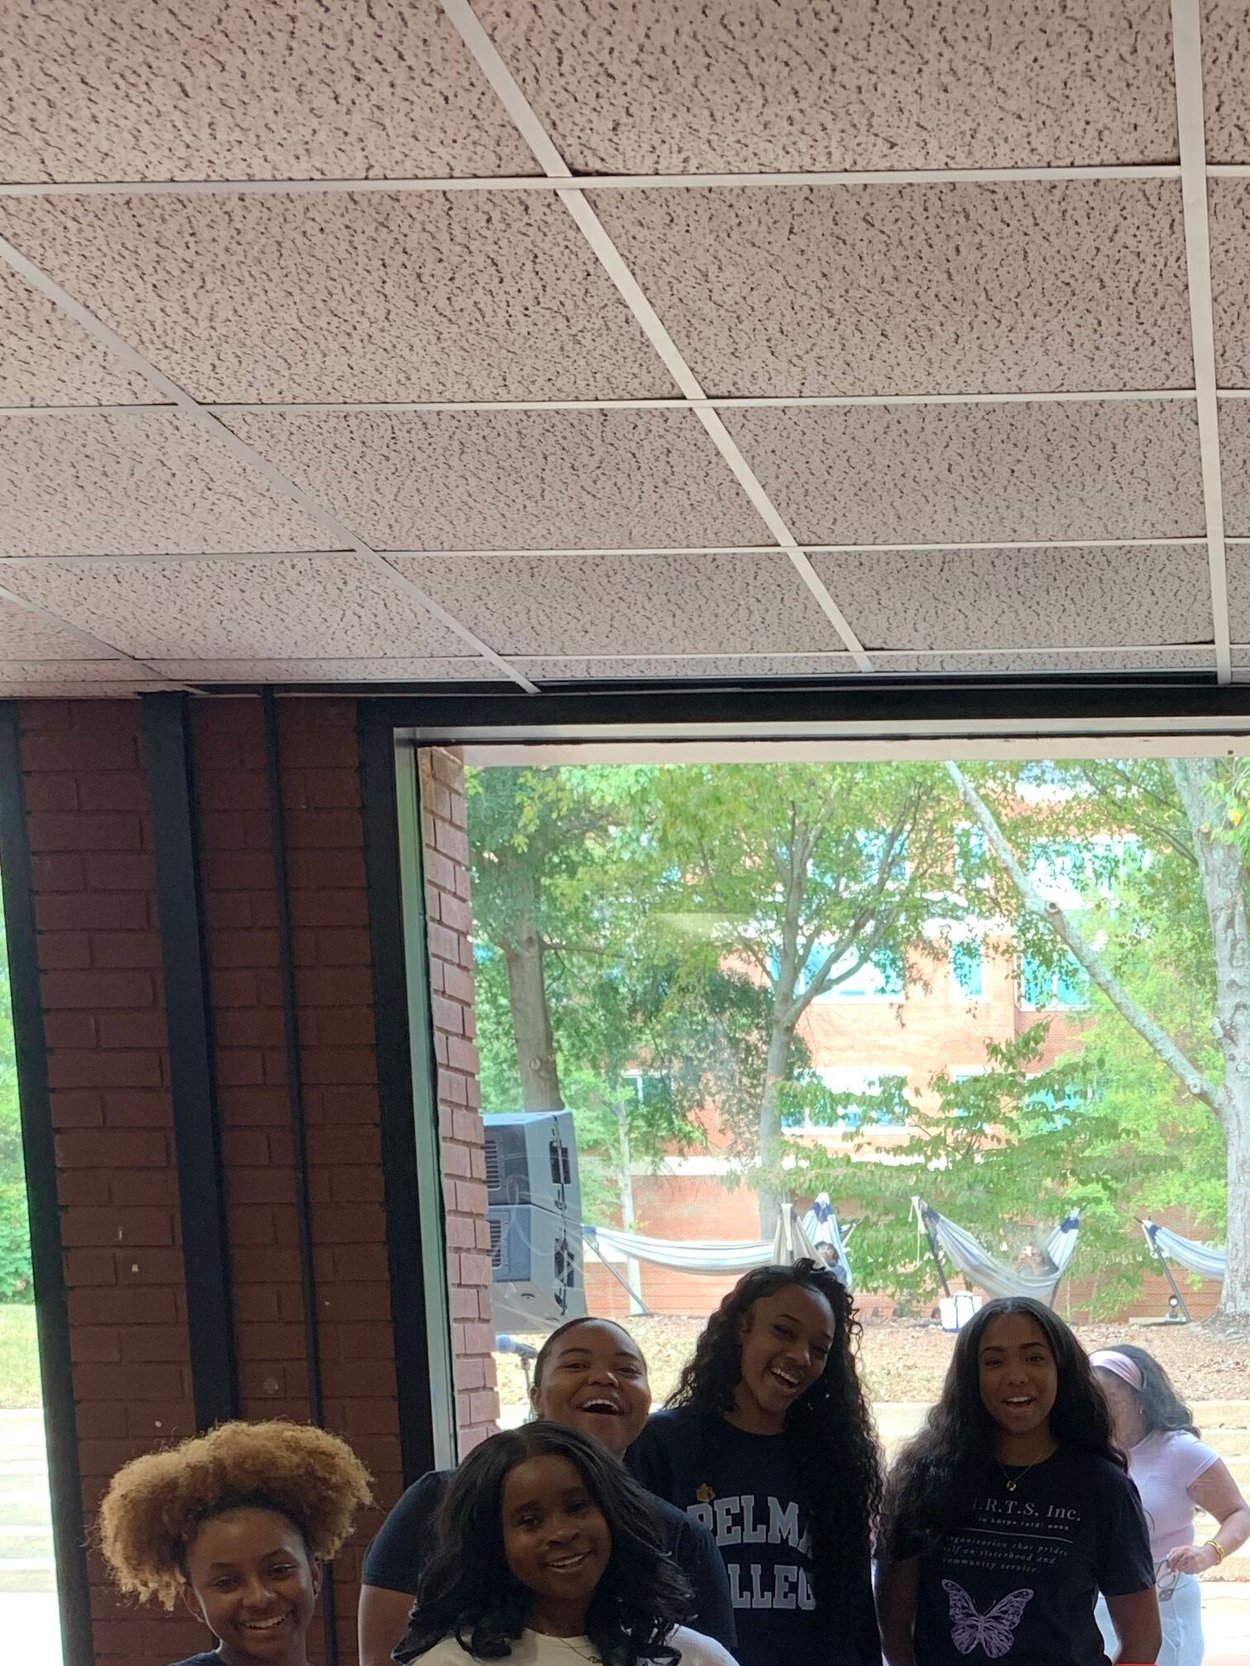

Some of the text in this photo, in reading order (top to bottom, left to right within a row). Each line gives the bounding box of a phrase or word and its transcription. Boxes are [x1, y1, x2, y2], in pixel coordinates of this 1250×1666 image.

[1047, 1505, 1081, 1521] Inc.
[687, 1495, 813, 1559] PELM
[943, 1557, 997, 1571] community
